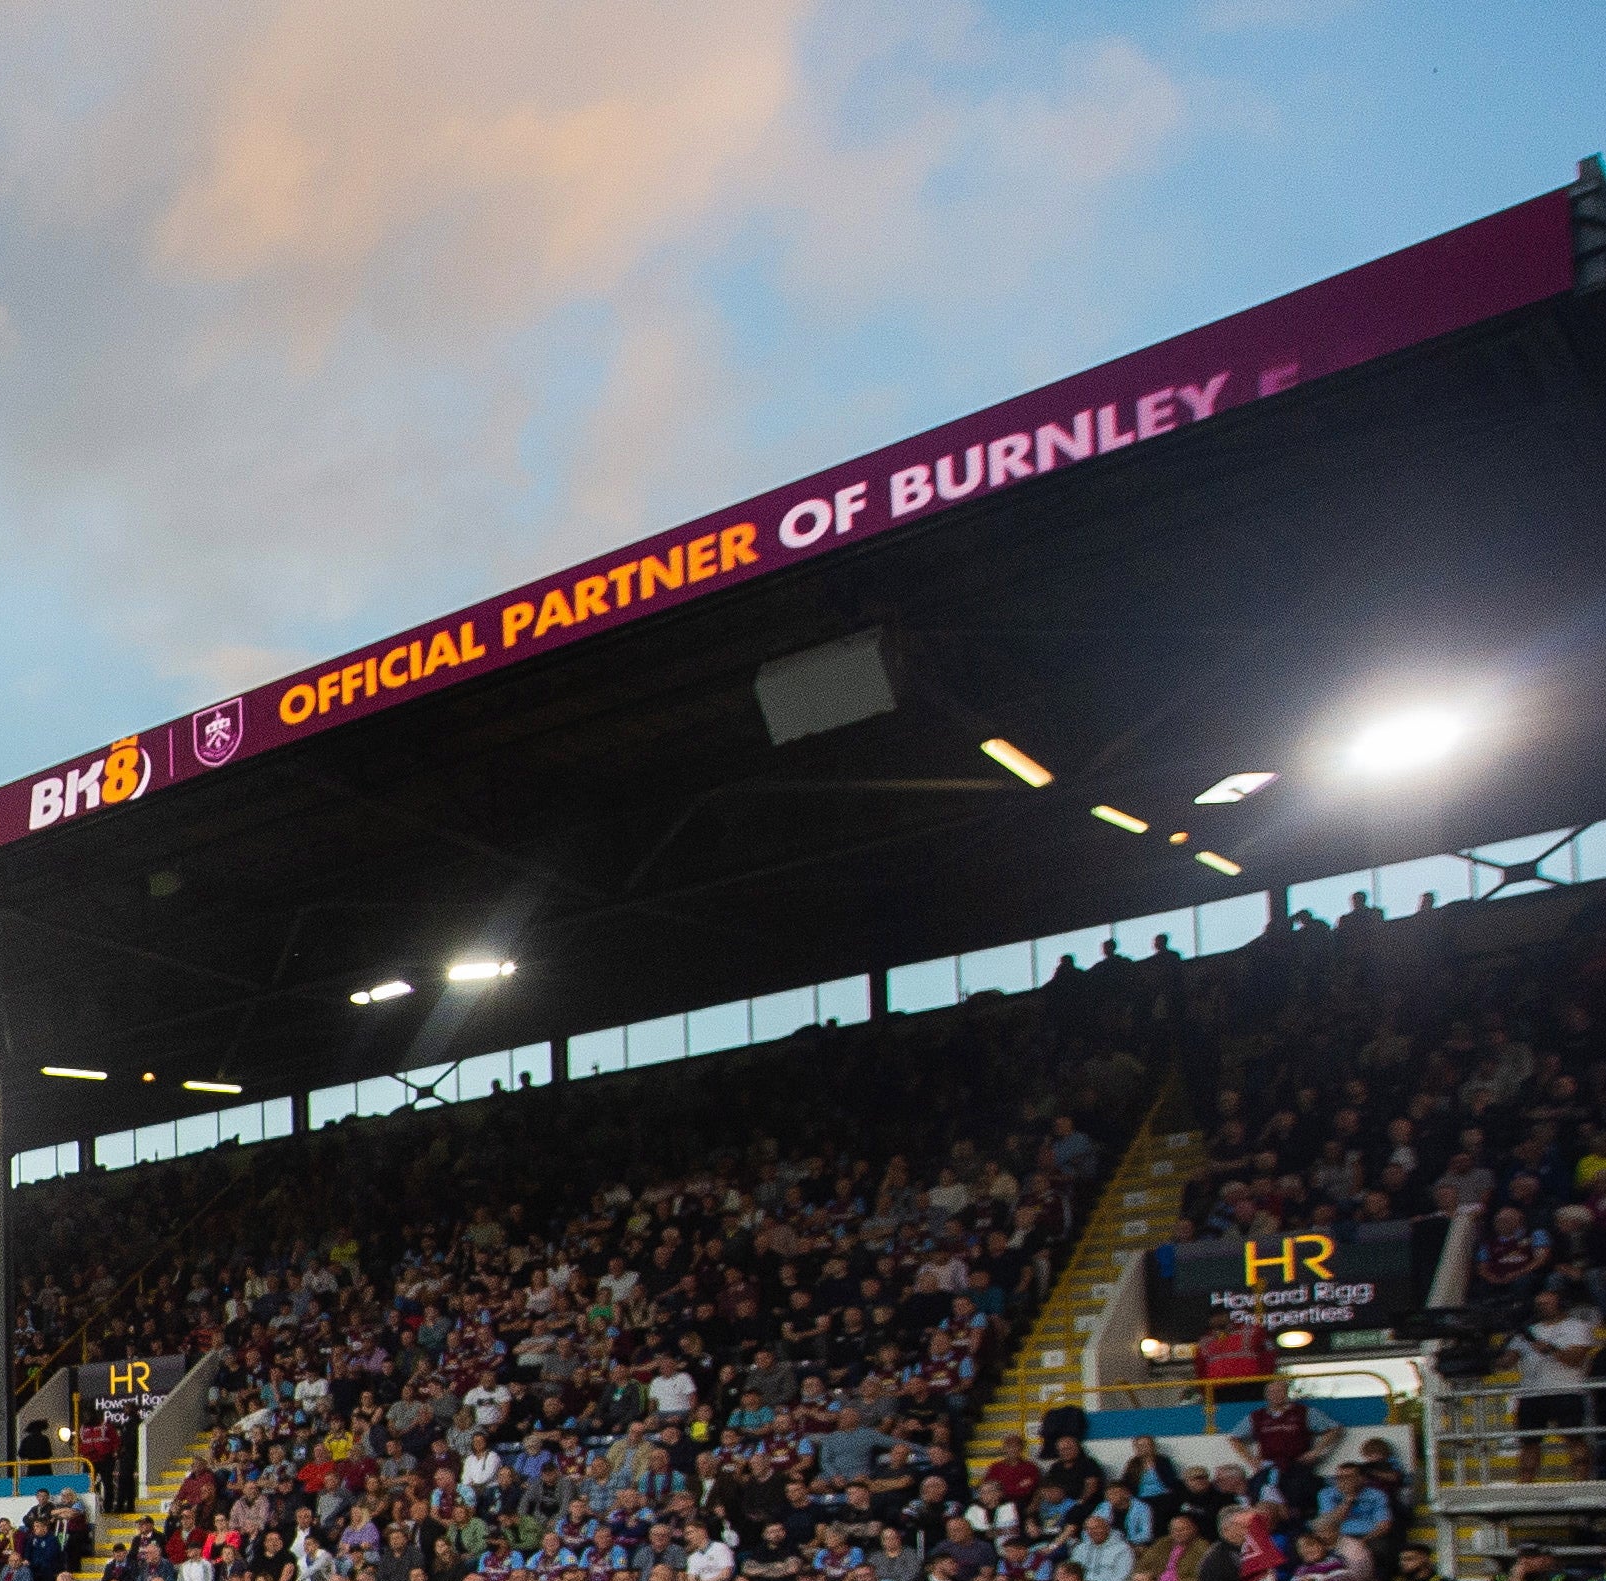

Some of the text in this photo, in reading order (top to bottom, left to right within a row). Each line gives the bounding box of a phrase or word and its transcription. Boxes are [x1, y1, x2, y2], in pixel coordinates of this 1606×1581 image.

[278, 622, 486, 725] OFFICIAL
[501, 522, 758, 648] PARTNER
[778, 480, 868, 549] OF
[889, 370, 1230, 519] BURNLEY
[29, 737, 150, 830] BK8
[1245, 1234, 1335, 1286] HR
[110, 1361, 151, 1395] HR
